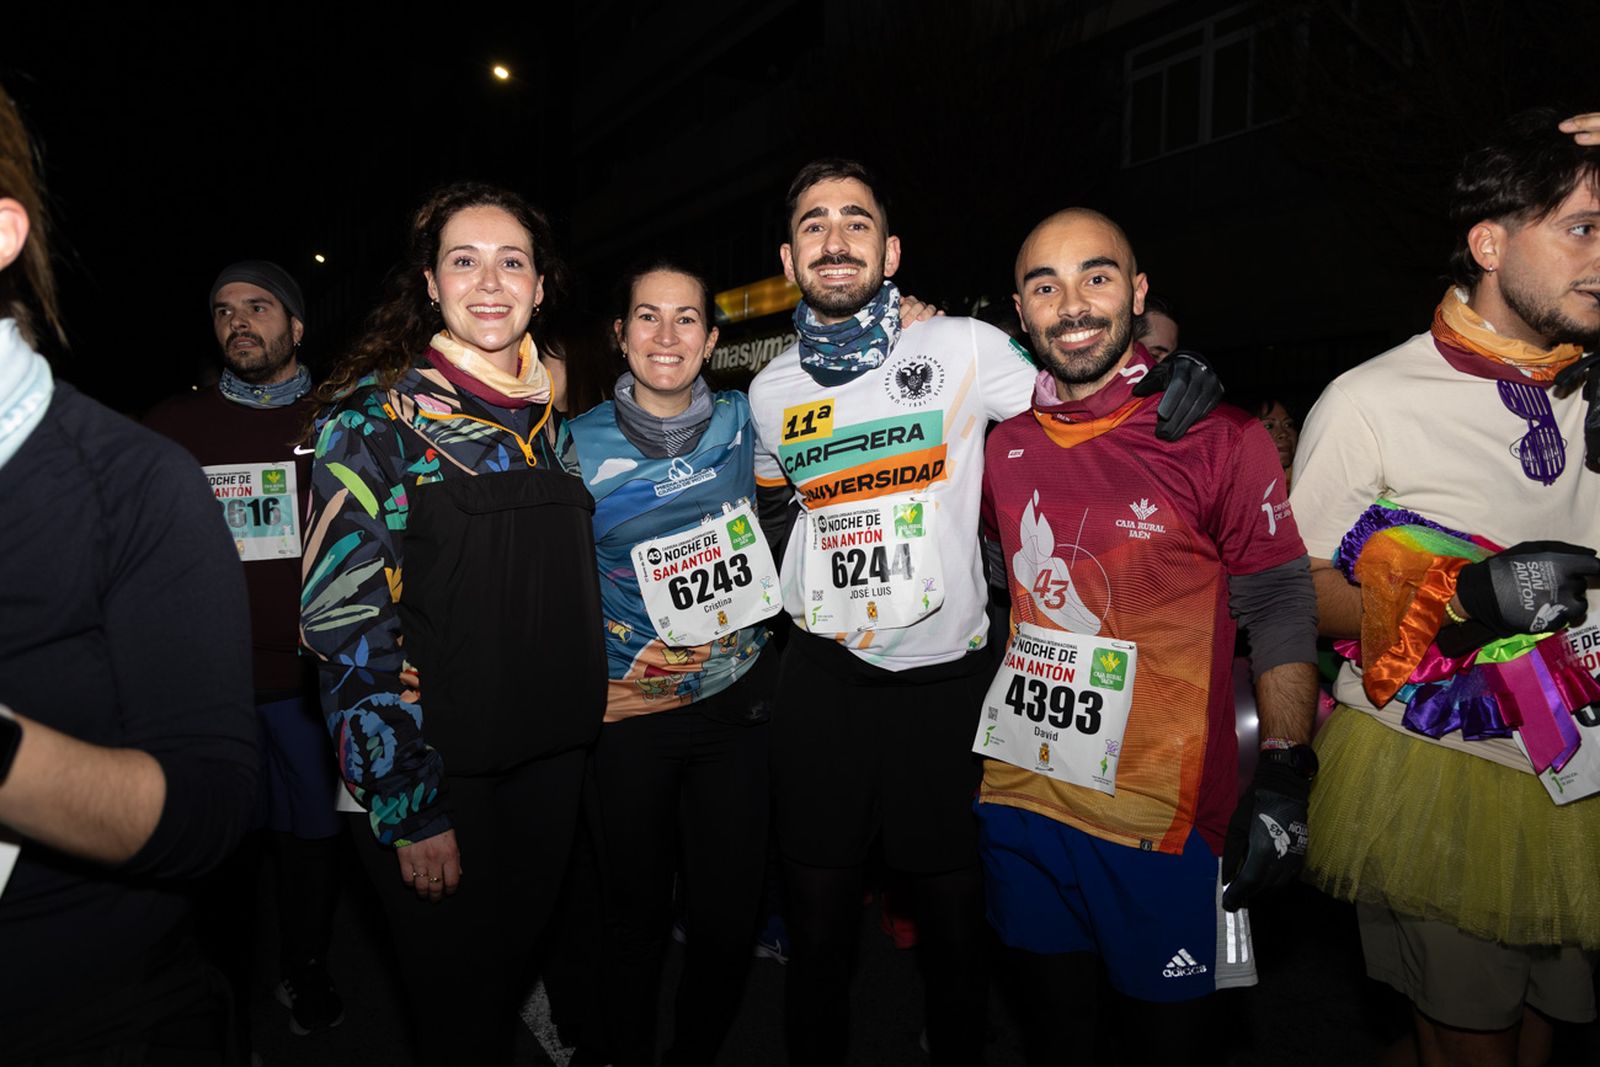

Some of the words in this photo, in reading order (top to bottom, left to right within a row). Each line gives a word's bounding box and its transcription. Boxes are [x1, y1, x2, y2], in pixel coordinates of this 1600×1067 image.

[711, 333, 798, 371] masyma
[784, 423, 925, 474] CARRERA
[214, 484, 252, 498] ANTÓN
[238, 475, 252, 484] DE
[828, 515, 862, 532] NOCHE
[866, 513, 881, 526] DE
[1115, 519, 1136, 529] CAJA
[1137, 521, 1166, 533] RURAL
[664, 539, 702, 562] NOCHE
[704, 533, 718, 547] DE
[821, 535, 838, 551] SAN
[840, 527, 883, 547] ANTÓN
[653, 563, 678, 582] SAN
[681, 546, 721, 572] ANTÓN
[831, 543, 915, 589] 6244
[1526, 562, 1544, 590] SAN
[668, 553, 752, 611] 6243
[850, 587, 869, 600] JOSÉ
[872, 586, 892, 598] LUIS
[1032, 569, 1069, 609] 43
[1513, 561, 1536, 611] ANTÓN
[704, 597, 732, 614] Cristina
[1017, 638, 1055, 661] NOCHE
[1058, 649, 1078, 664] DE
[1004, 652, 1024, 670] SAN
[1026, 663, 1076, 684] ANTÓN
[1005, 674, 1104, 735] 4393
[1034, 726, 1059, 742] David
[1163, 965, 1207, 978] adidas
